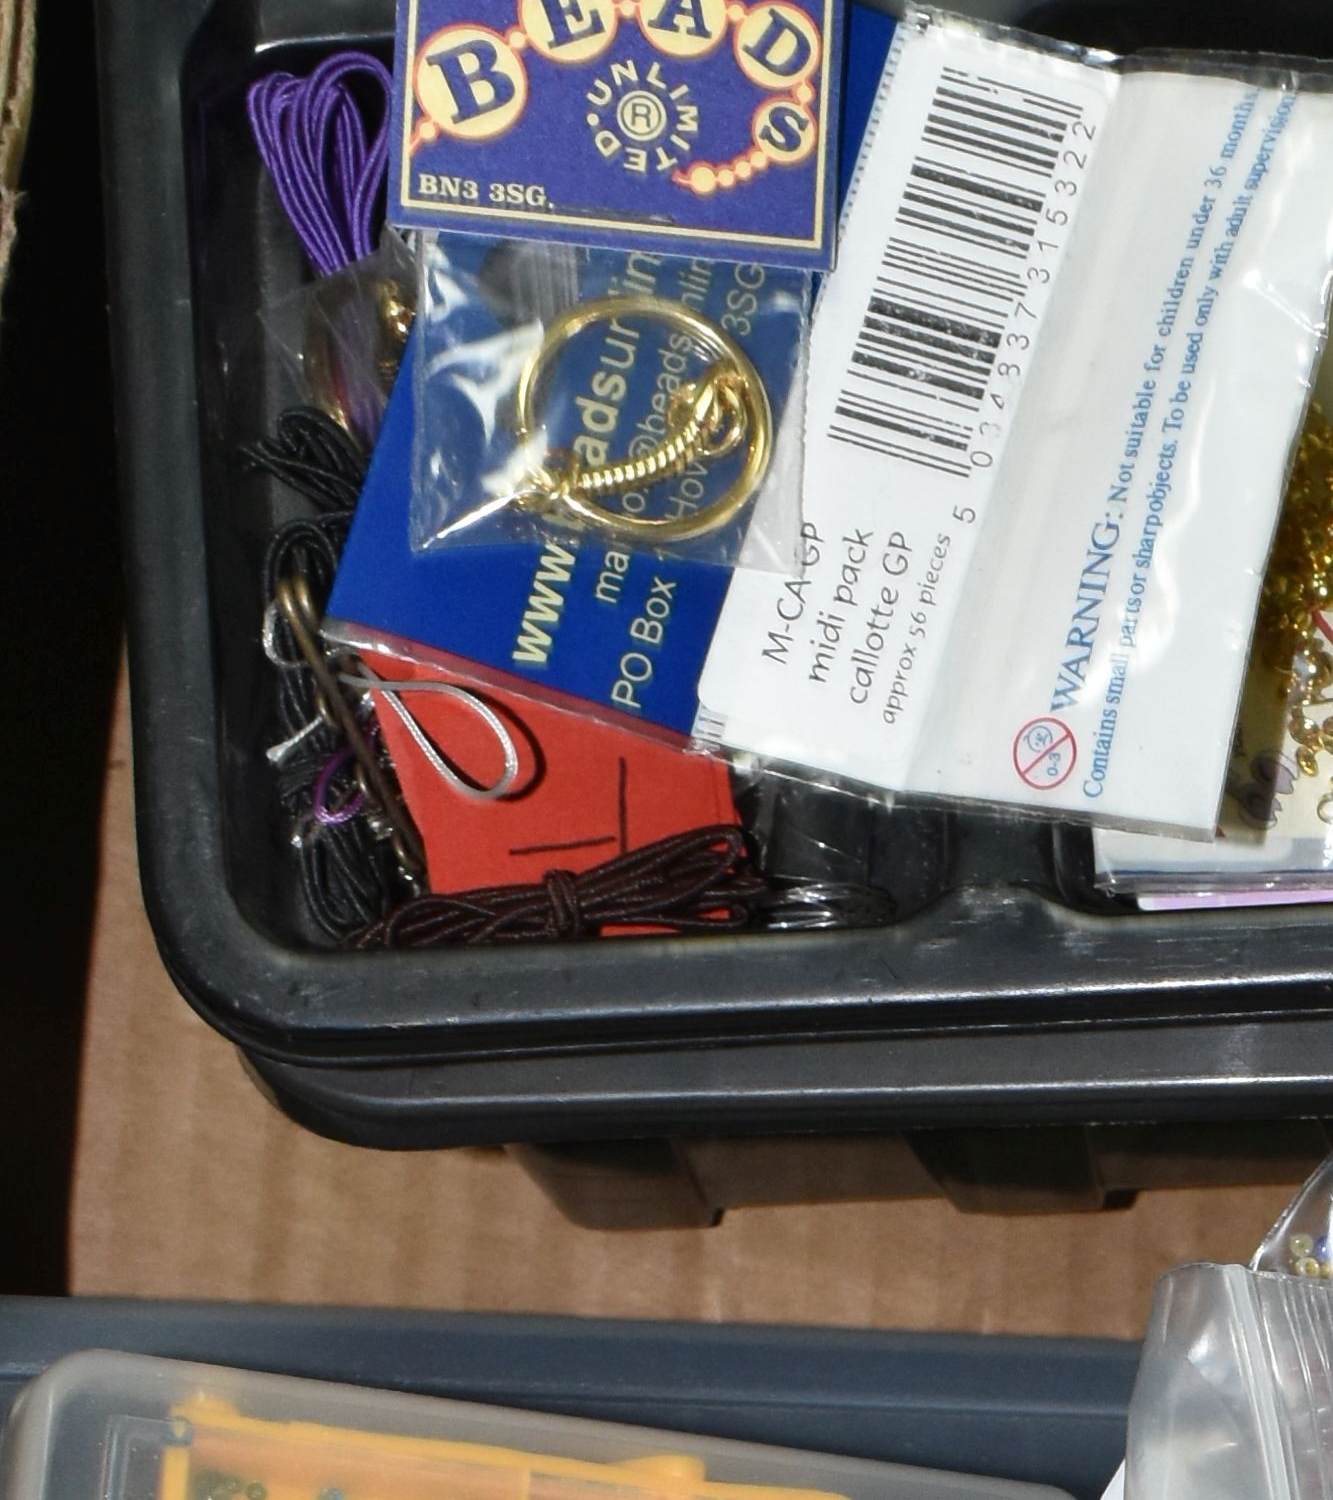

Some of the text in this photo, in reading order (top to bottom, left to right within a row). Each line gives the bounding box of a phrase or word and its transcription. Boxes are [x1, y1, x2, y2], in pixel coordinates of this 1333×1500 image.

[417, 172, 481, 203] BN3
[1203, 161, 1227, 189] 36
[1183, 194, 1219, 252] under
[1220, 190, 1254, 240] adult
[1206, 236, 1234, 285] with
[1152, 253, 1197, 339] children
[1195, 288, 1222, 330] only
[1143, 344, 1166, 371] for
[1176, 328, 1207, 377] used
[1168, 376, 1194, 403] be
[1124, 380, 1157, 458] suitable
[1161, 408, 1185, 432] To
[1108, 463, 1135, 503] Not
[808, 528, 874, 683] midi pack
[850, 531, 913, 704] callotte GP
[882, 533, 951, 725] approx 56 pieces
[1049, 509, 1123, 710] WARNING:
[611, 577, 676, 708] PO Box
[1080, 709, 1120, 798] Contains
